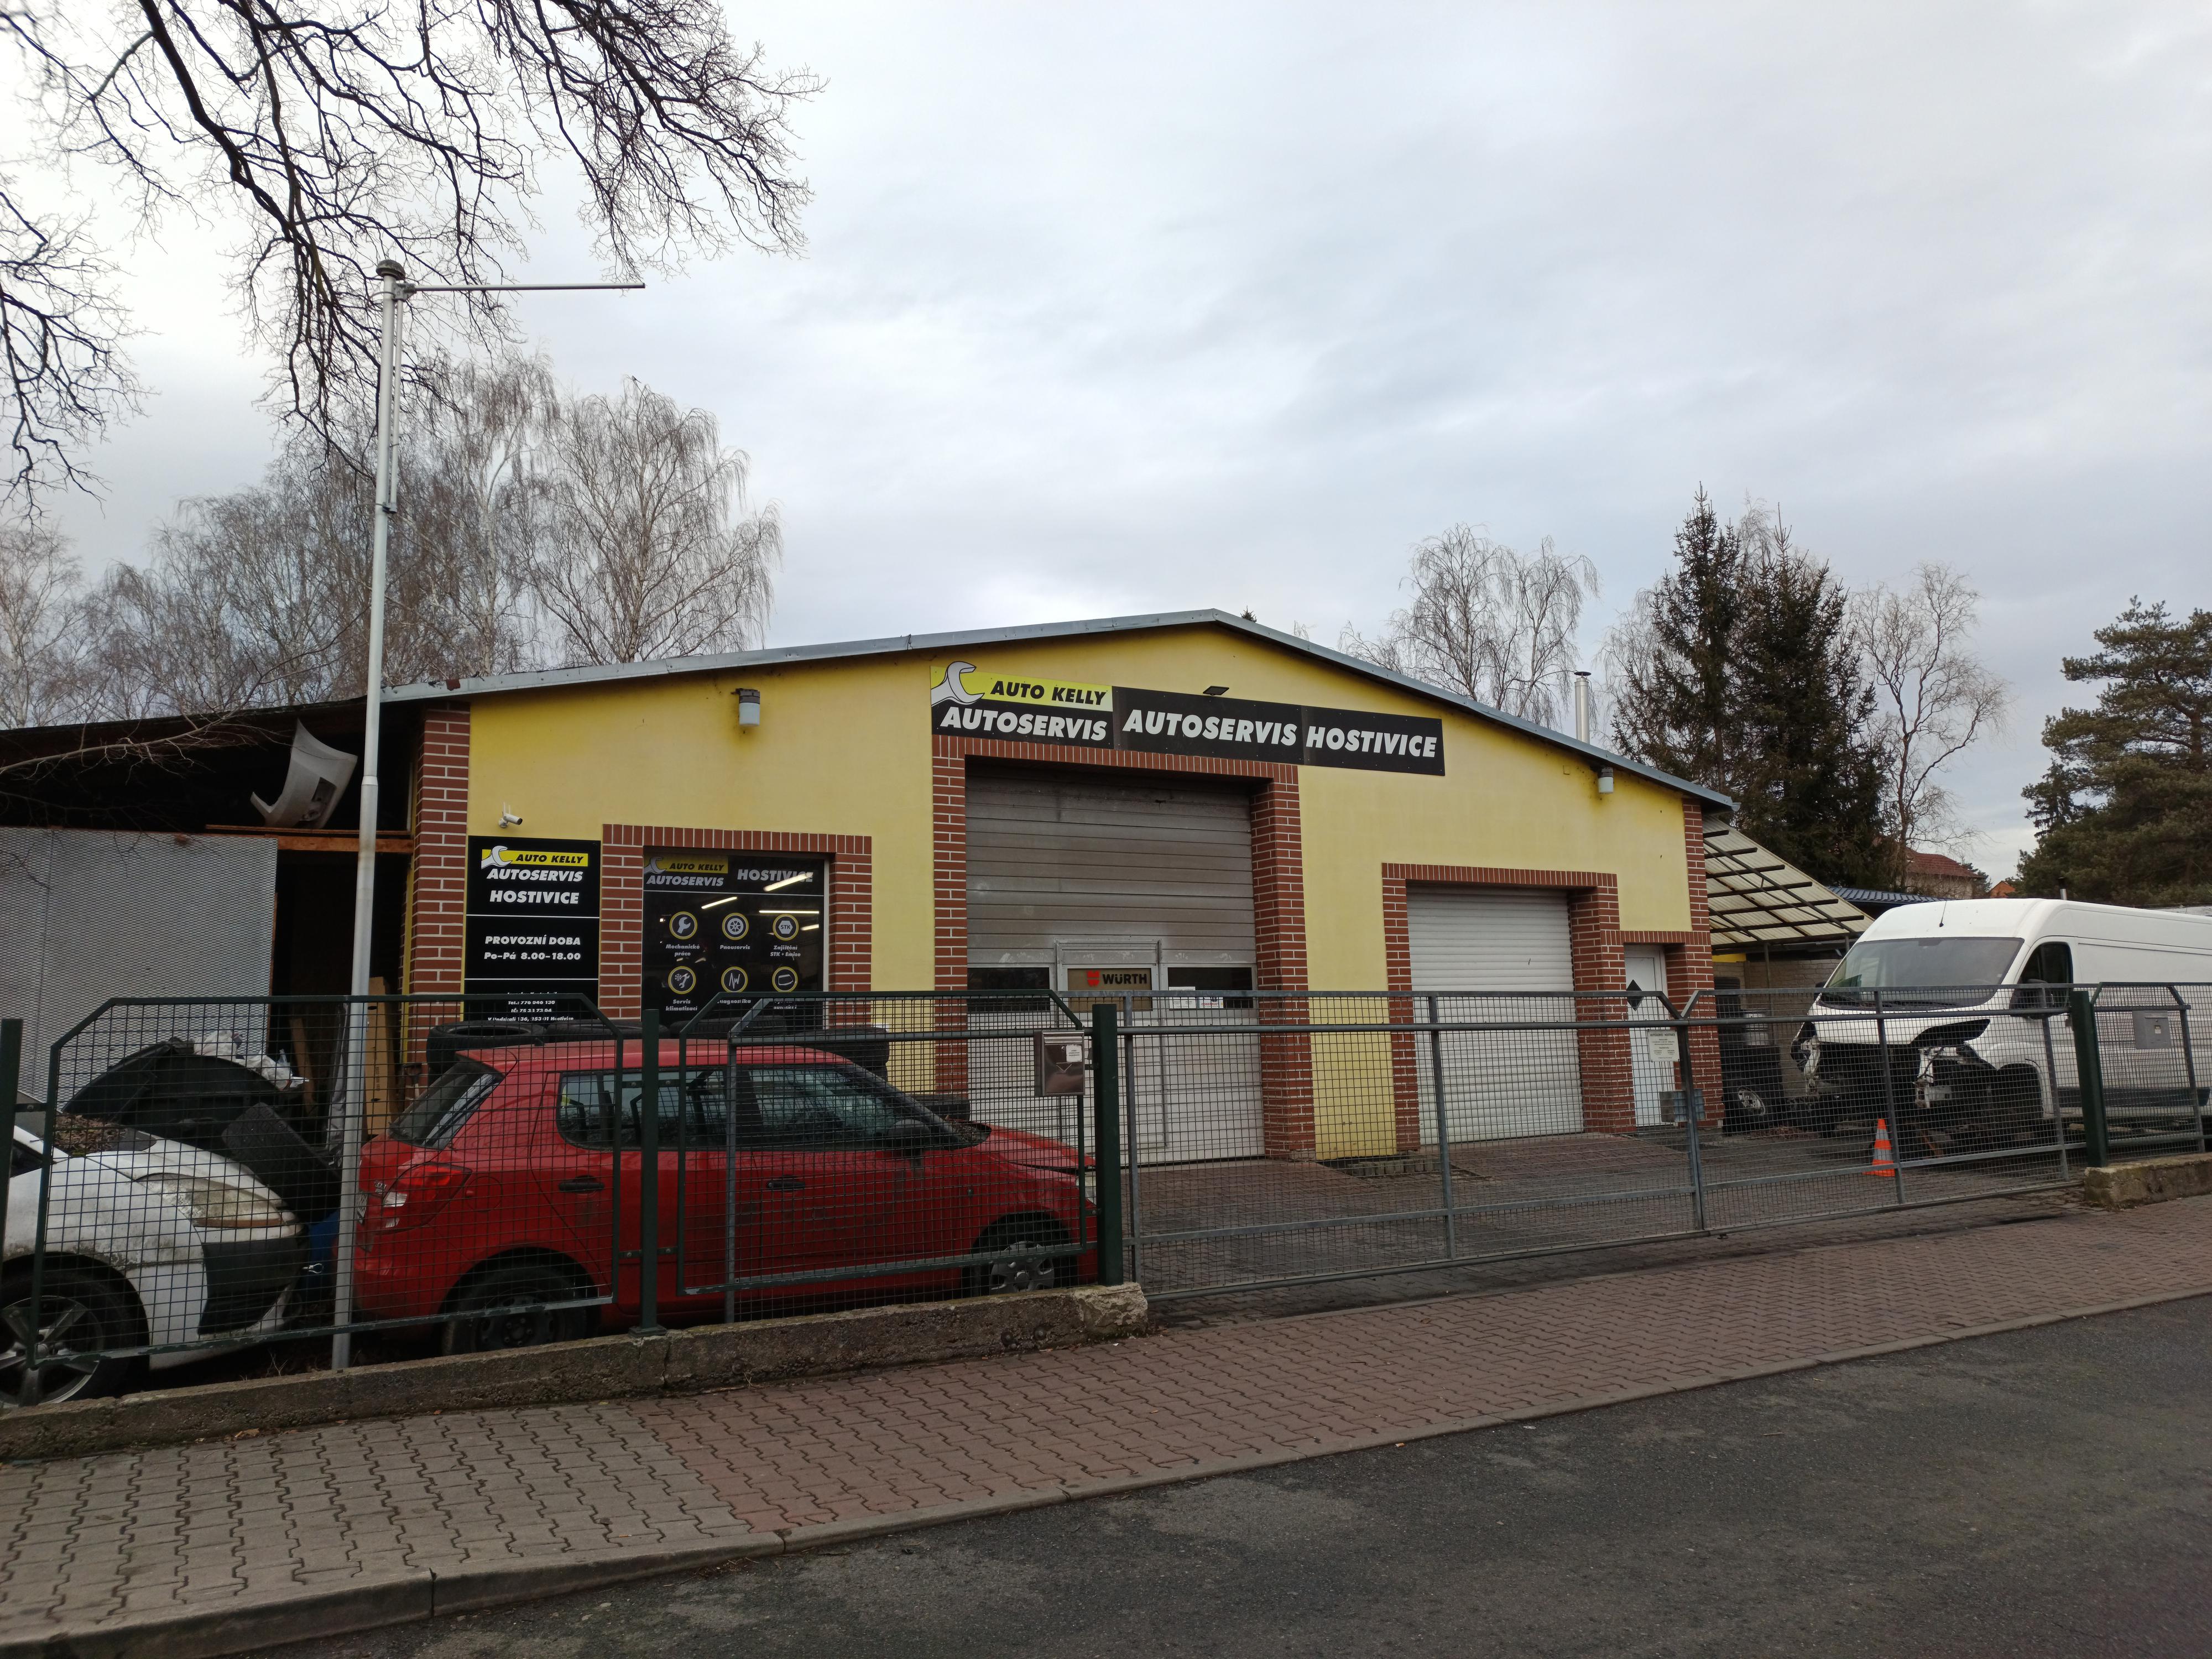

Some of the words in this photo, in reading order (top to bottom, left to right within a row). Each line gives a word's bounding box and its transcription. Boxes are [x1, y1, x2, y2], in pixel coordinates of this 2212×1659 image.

[990, 680, 1045, 699] AUTO
[1051, 687, 1107, 706] KELLY
[940, 707, 1107, 741] AUTOSERVIS
[1123, 709, 1298, 746] AUTOSERVIS
[1306, 726, 1438, 758] HOSTIVICE
[515, 854, 547, 863] AUTO
[551, 855, 584, 864] KELLY
[487, 868, 583, 882] AUTOSERVIS
[646, 875, 724, 886] AUTOSERVIS
[489, 890, 580, 904] HOSTIVICE
[484, 934, 547, 945] PROVOZNÍ
[549, 937, 581, 945] DOBA
[484, 951, 517, 959] Po-Pá
[1102, 974, 1147, 985] WÜRTH
